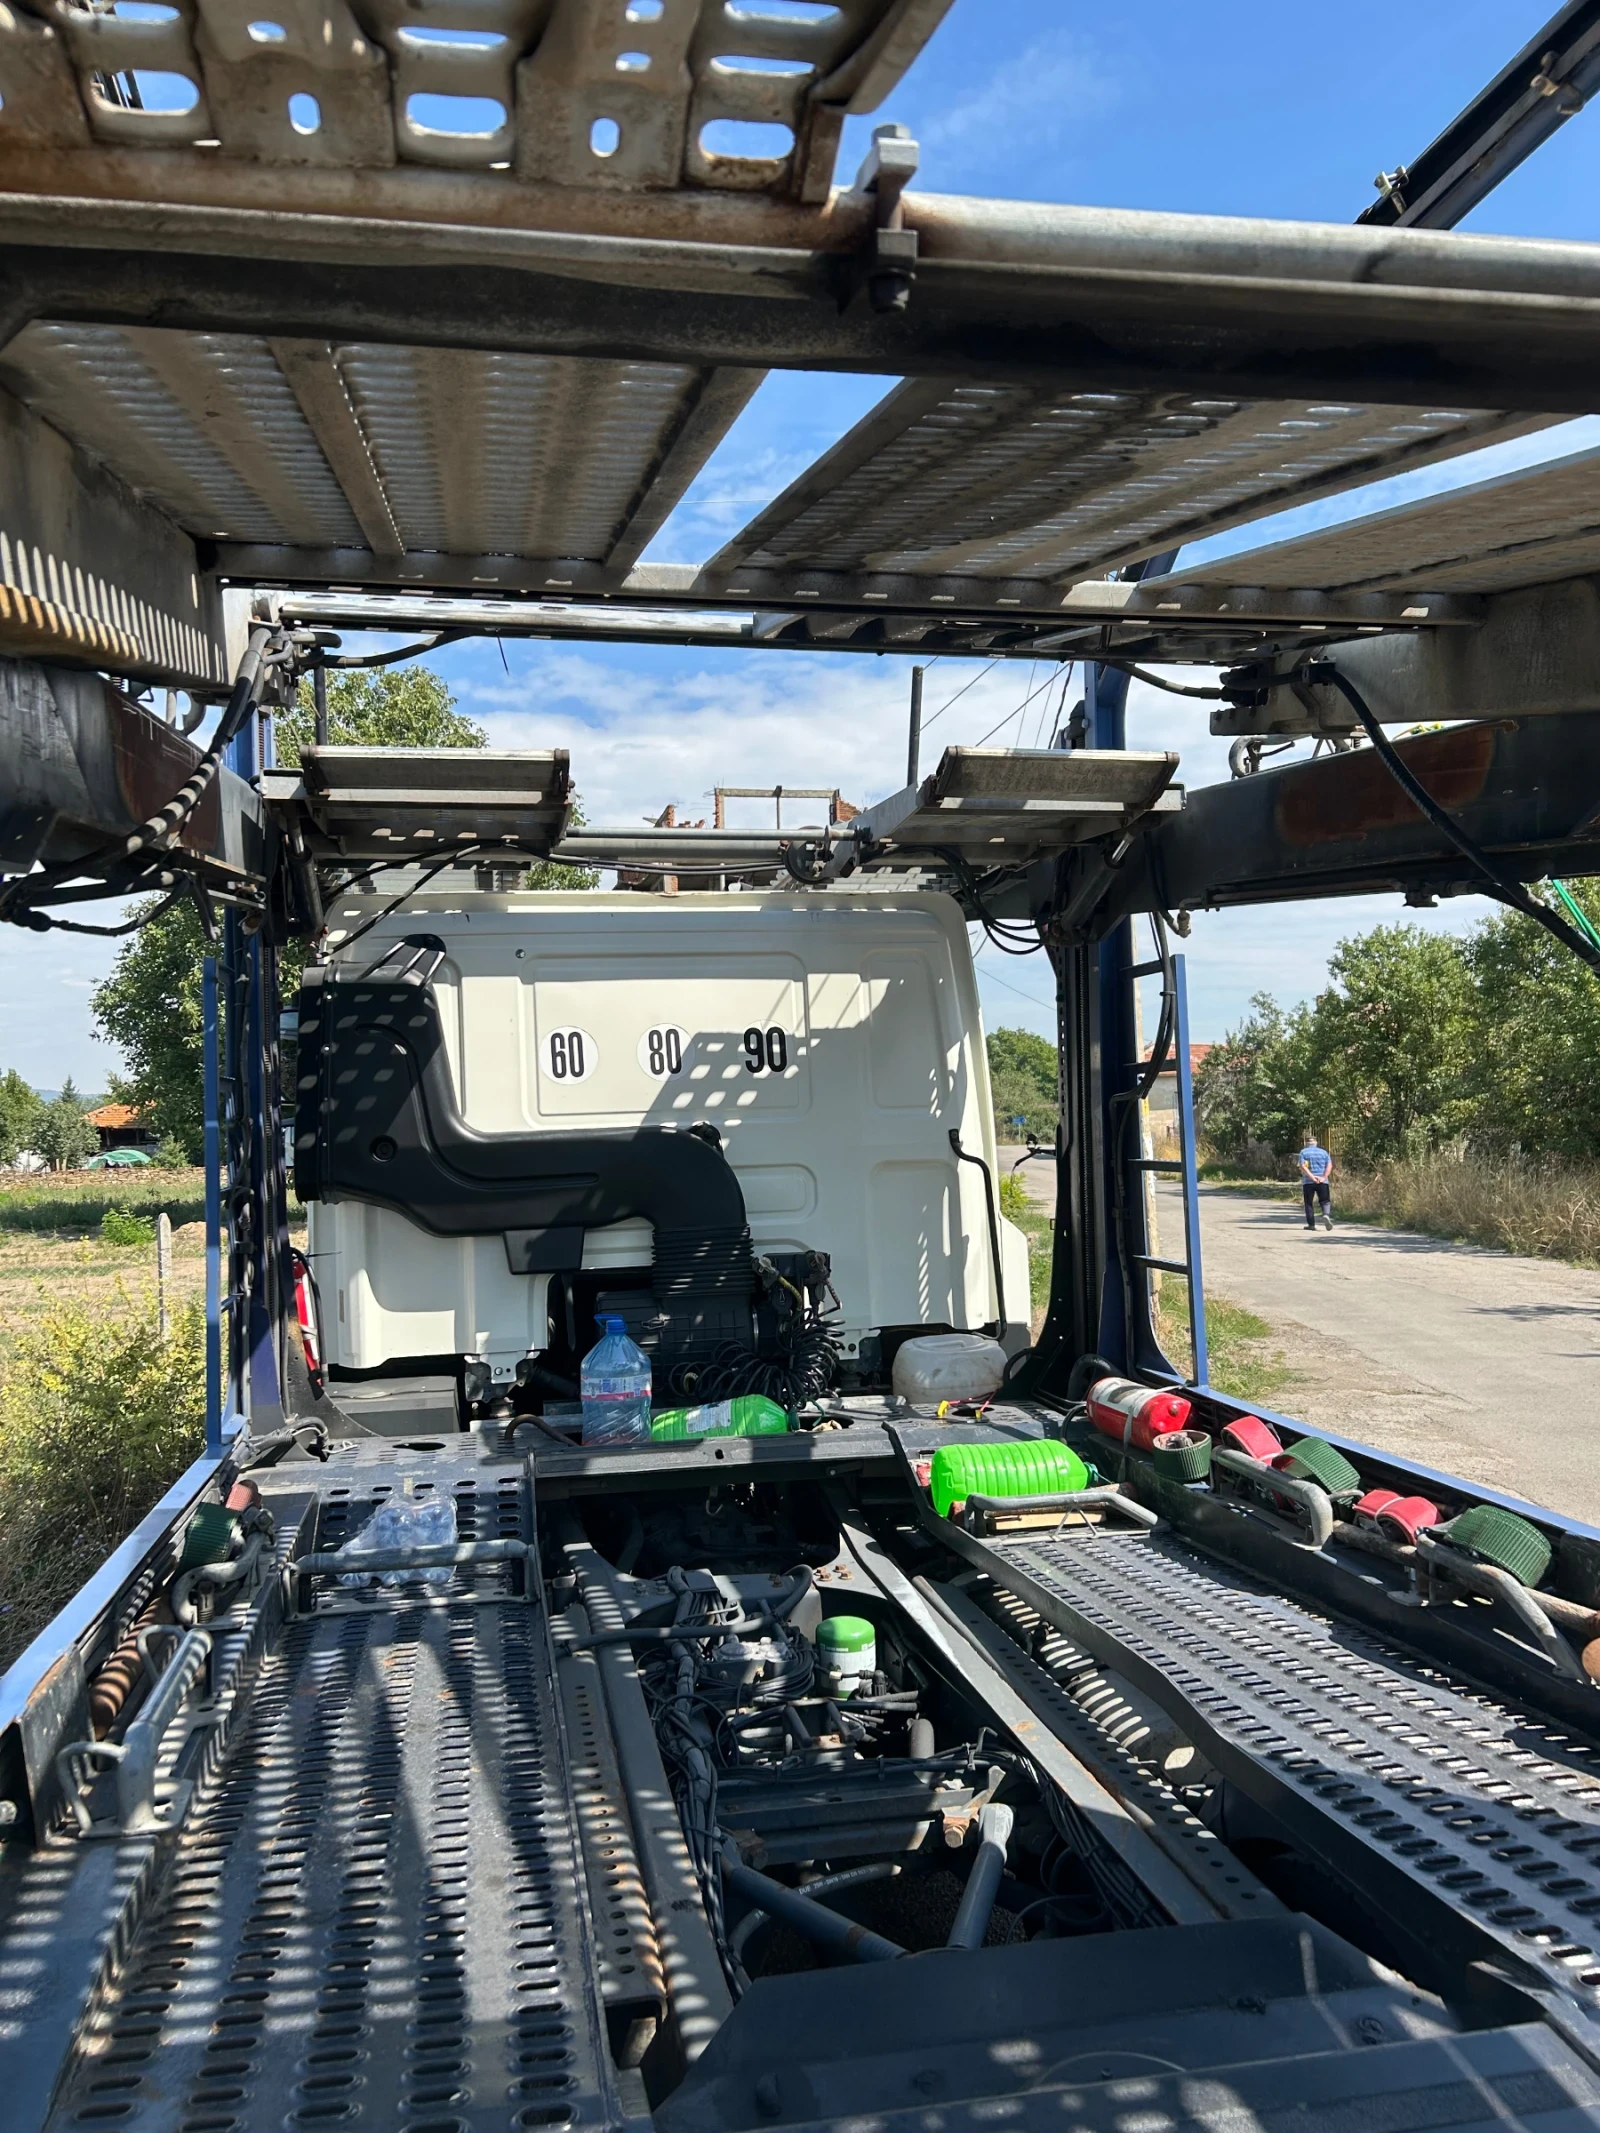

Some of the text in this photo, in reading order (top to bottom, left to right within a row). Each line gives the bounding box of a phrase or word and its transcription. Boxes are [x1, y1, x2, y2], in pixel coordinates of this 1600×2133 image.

[550, 1031, 585, 1079] 60
[648, 1028, 683, 1075] 80
[743, 1026, 788, 1074] 90
